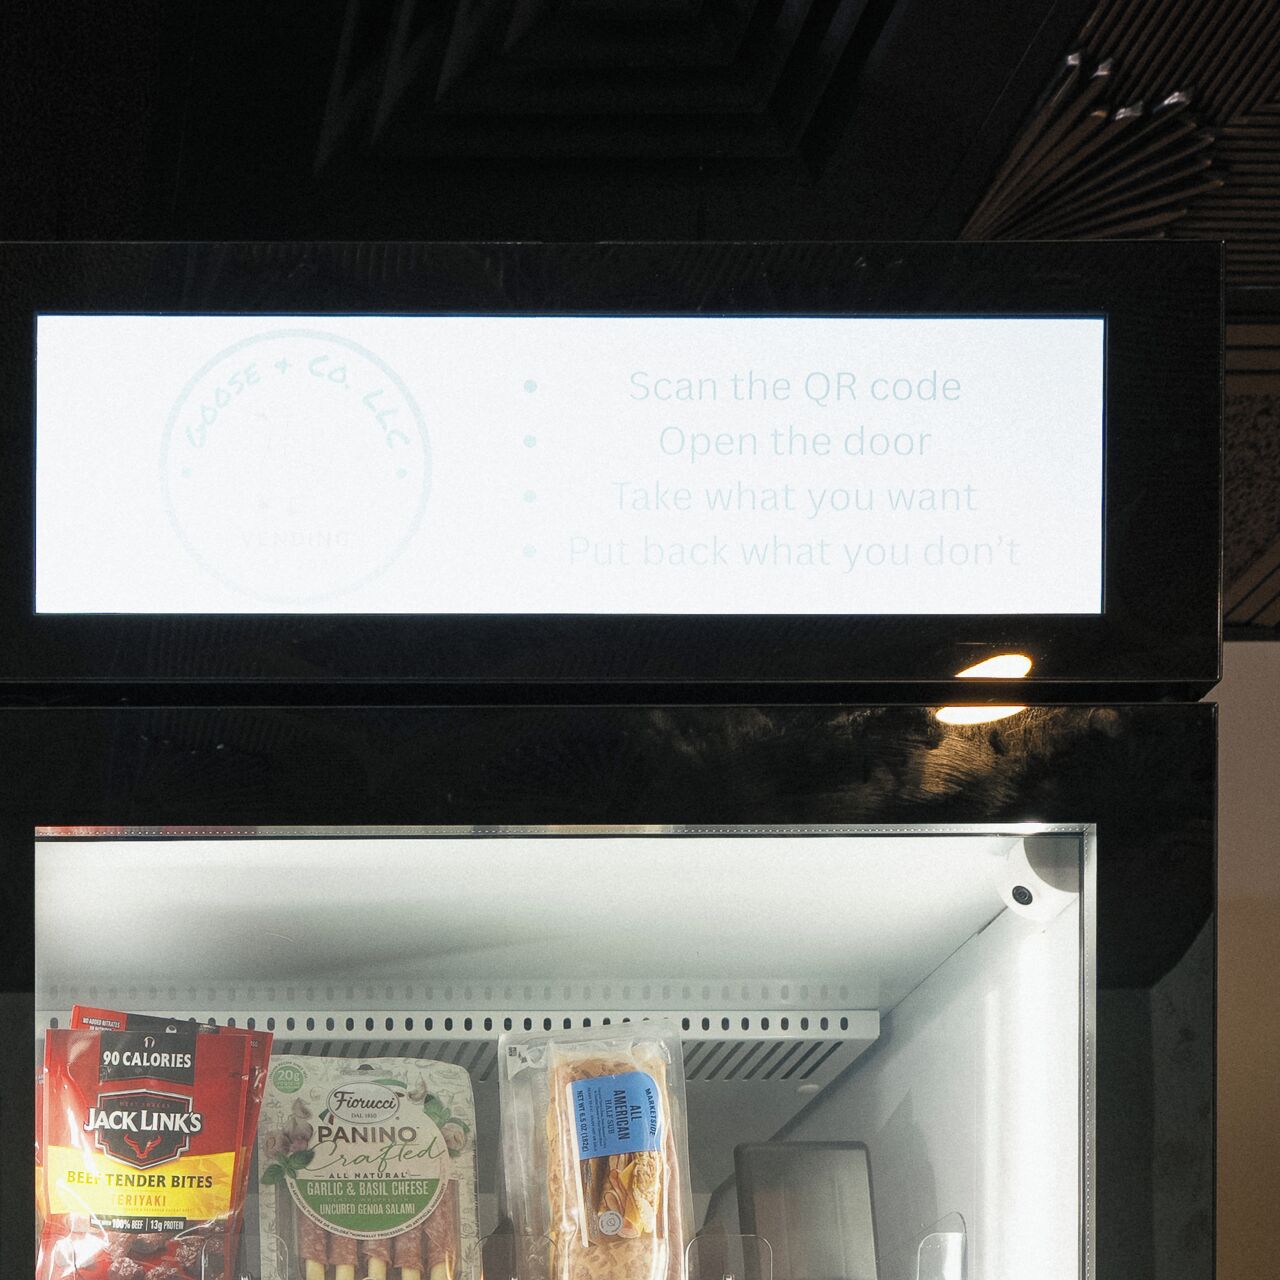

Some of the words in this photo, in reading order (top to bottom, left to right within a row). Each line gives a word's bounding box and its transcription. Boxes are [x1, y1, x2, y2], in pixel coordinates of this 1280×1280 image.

[629, 371, 717, 402] Scan
[733, 371, 792, 402] the
[804, 372, 860, 407] QR
[871, 371, 963, 402] code
[363, 388, 413, 450] LLC
[660, 427, 759, 465] Open
[771, 425, 831, 457] the
[842, 425, 931, 457] door
[612, 480, 696, 512] Take
[706, 480, 796, 512] what
[806, 490, 875, 521] you
[886, 484, 978, 512] want
[570, 536, 631, 567] Put
[643, 535, 727, 567] back
[741, 536, 831, 567] what
[842, 544, 910, 576] you
[921, 535, 1022, 567] don't
[103, 1051, 120, 1066] 90
[122, 1051, 192, 1068] CALORIES
[277, 1070, 300, 1084] 20g
[333, 1091, 396, 1111] Fiorucci
[578, 1102, 585, 1112] WT
[613, 1090, 630, 1140] AMERICAN
[630, 1105, 642, 1121] ALL
[645, 1088, 656, 1135] MARKETSIDE
[83, 1108, 138, 1133] JACK
[140, 1109, 202, 1133] LINK'S
[581, 1123, 587, 1131] OZ
[318, 1126, 417, 1143] PANINO
[304, 1137, 446, 1172] Crafted
[106, 1174, 166, 1188] TENDER
[171, 1175, 213, 1189] BITES
[307, 1182, 343, 1196] GARLIC
[346, 1182, 356, 1196] &
[359, 1182, 388, 1196] BASIL
[391, 1181, 429, 1195] CHEESE
[112, 1194, 166, 1207] ERIYAKI
[320, 1203, 356, 1215] UNCURED
[358, 1203, 384, 1215] GENOA
[386, 1203, 415, 1215] SALAMI
[131, 1219, 144, 1229] BEEF
[150, 1220, 163, 1231] 13g
[163, 1221, 184, 1230] PROTEIN
